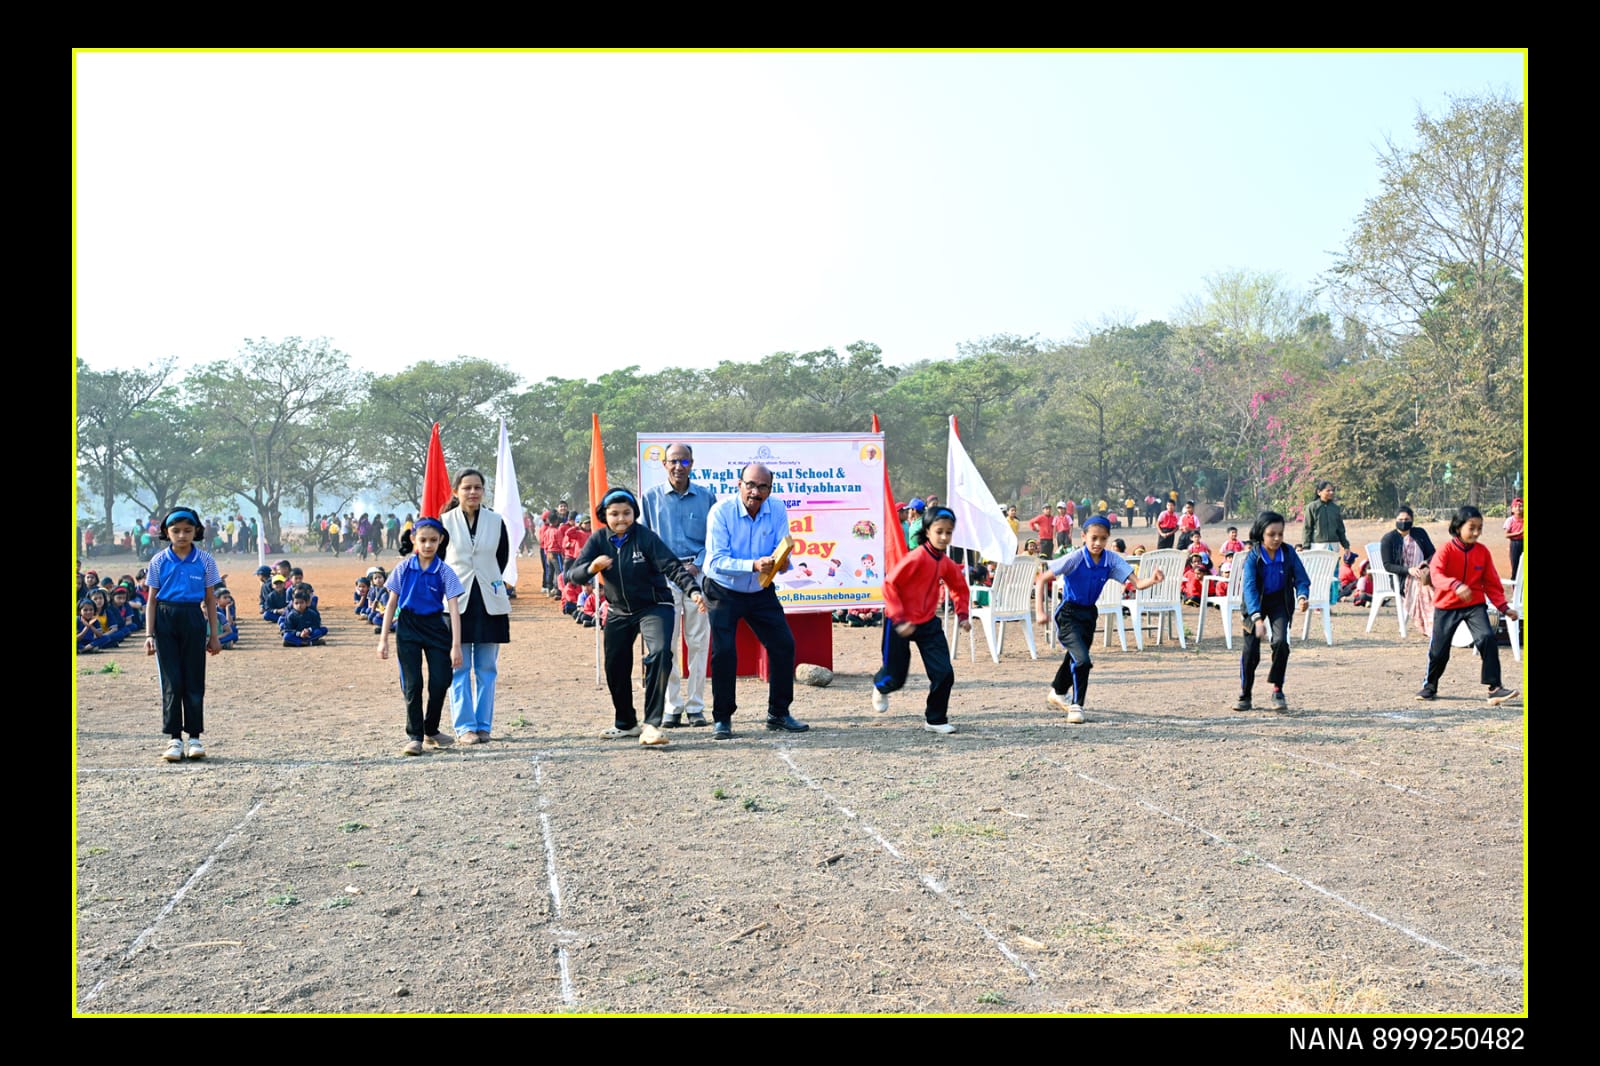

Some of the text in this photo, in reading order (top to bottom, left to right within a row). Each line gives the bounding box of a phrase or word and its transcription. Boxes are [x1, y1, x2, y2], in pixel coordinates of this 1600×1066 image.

[795, 467, 834, 480] School
[836, 467, 846, 479] &
[788, 481, 862, 495] Vidyabhavan
[791, 538, 836, 559] Day
